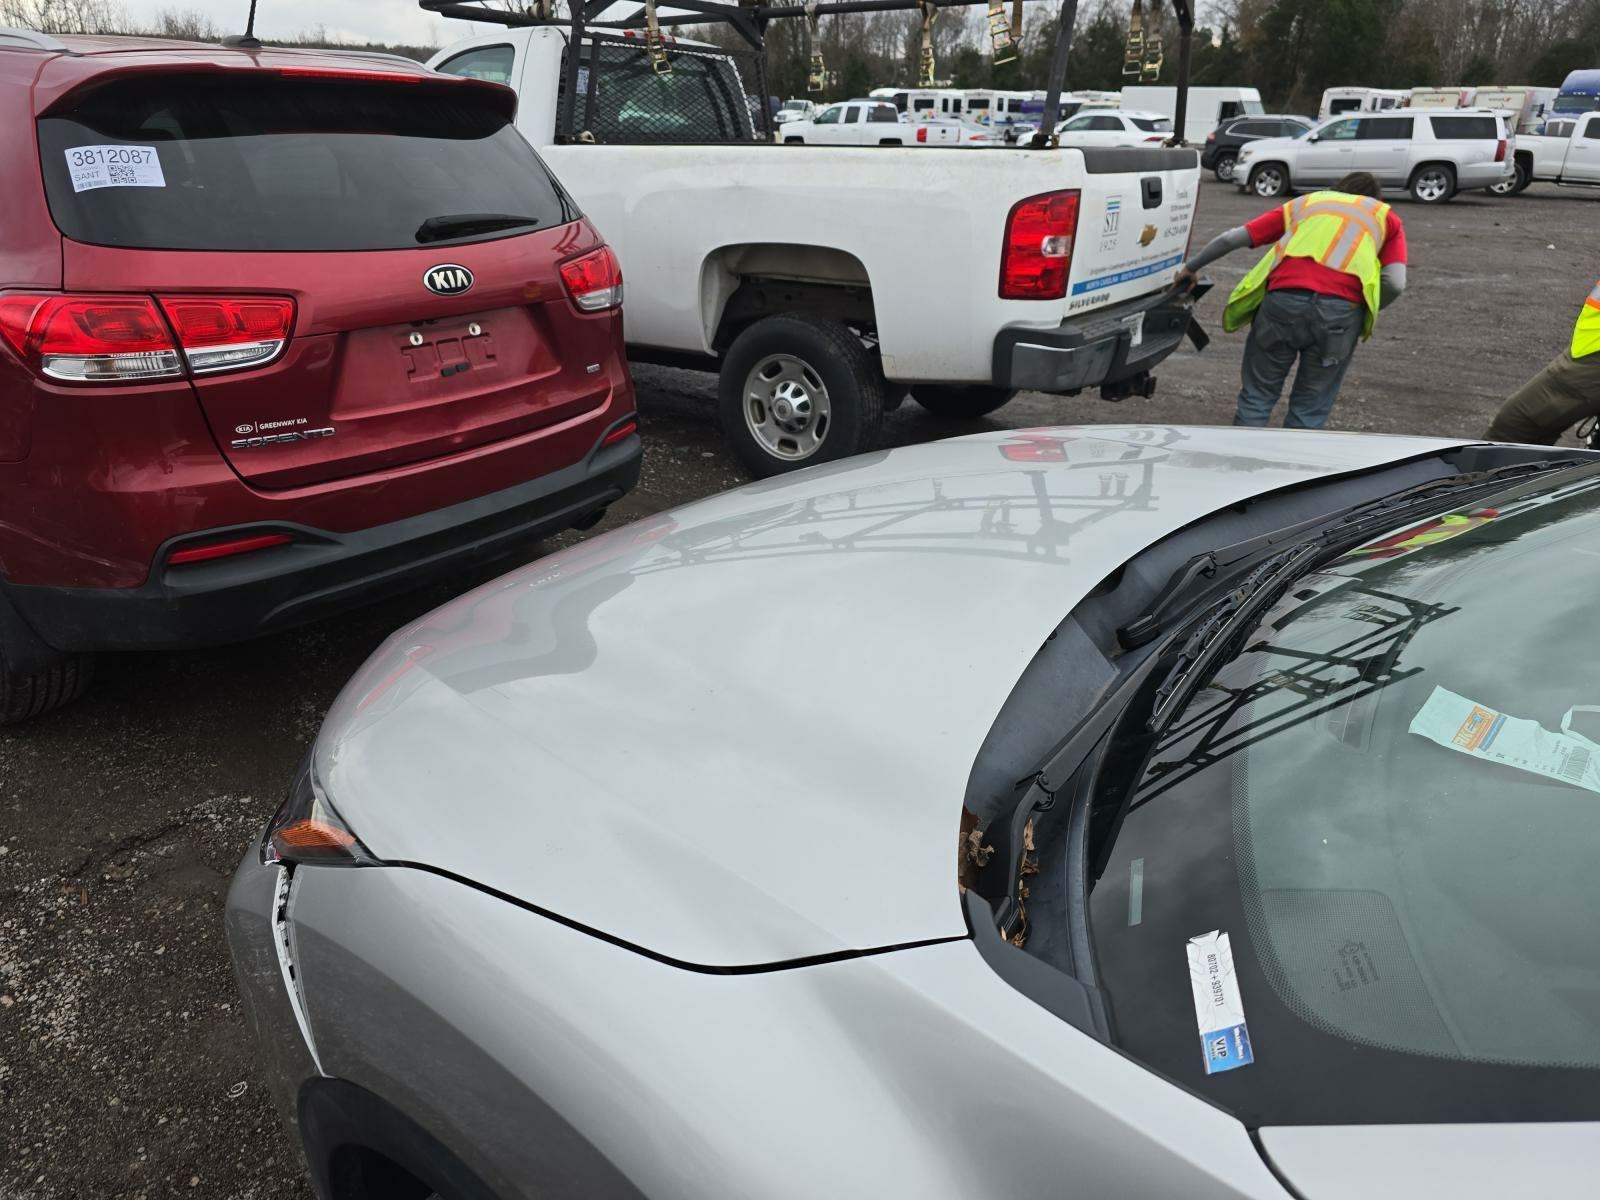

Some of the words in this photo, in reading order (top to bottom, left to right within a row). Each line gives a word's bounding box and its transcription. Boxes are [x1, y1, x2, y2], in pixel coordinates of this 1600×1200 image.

[72, 149, 152, 167] 3812087
[74, 170, 100, 182] SANT
[432, 269, 469, 290] KIA
[1069, 292, 1110, 310] SILVERADO
[259, 420, 295, 430] GREENWAY
[296, 417, 308, 425] KIA
[231, 427, 335, 449] SORENTO
[1216, 1037, 1228, 1058] VIP
